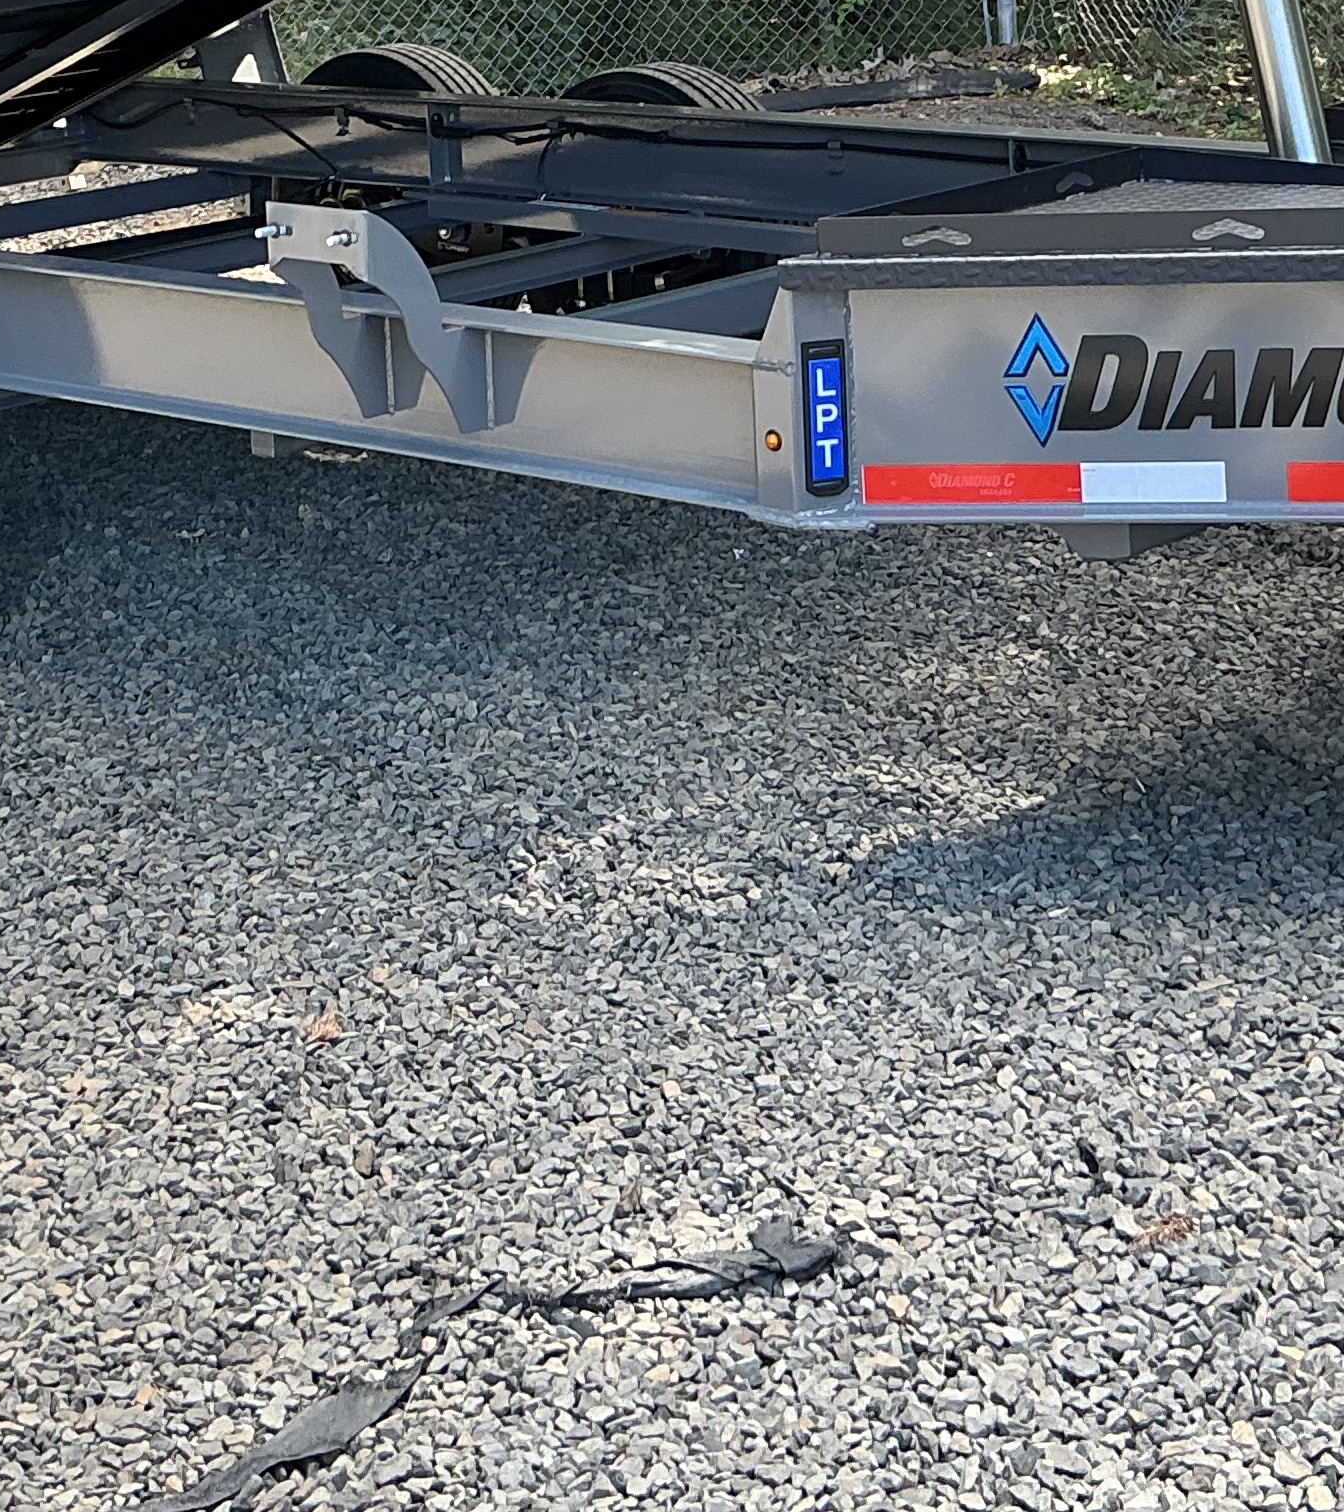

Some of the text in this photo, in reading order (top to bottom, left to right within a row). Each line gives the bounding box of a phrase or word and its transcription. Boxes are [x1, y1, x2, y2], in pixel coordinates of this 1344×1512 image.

[816, 368, 839, 468] LPT
[937, 472, 1016, 487] DIAMOND C
